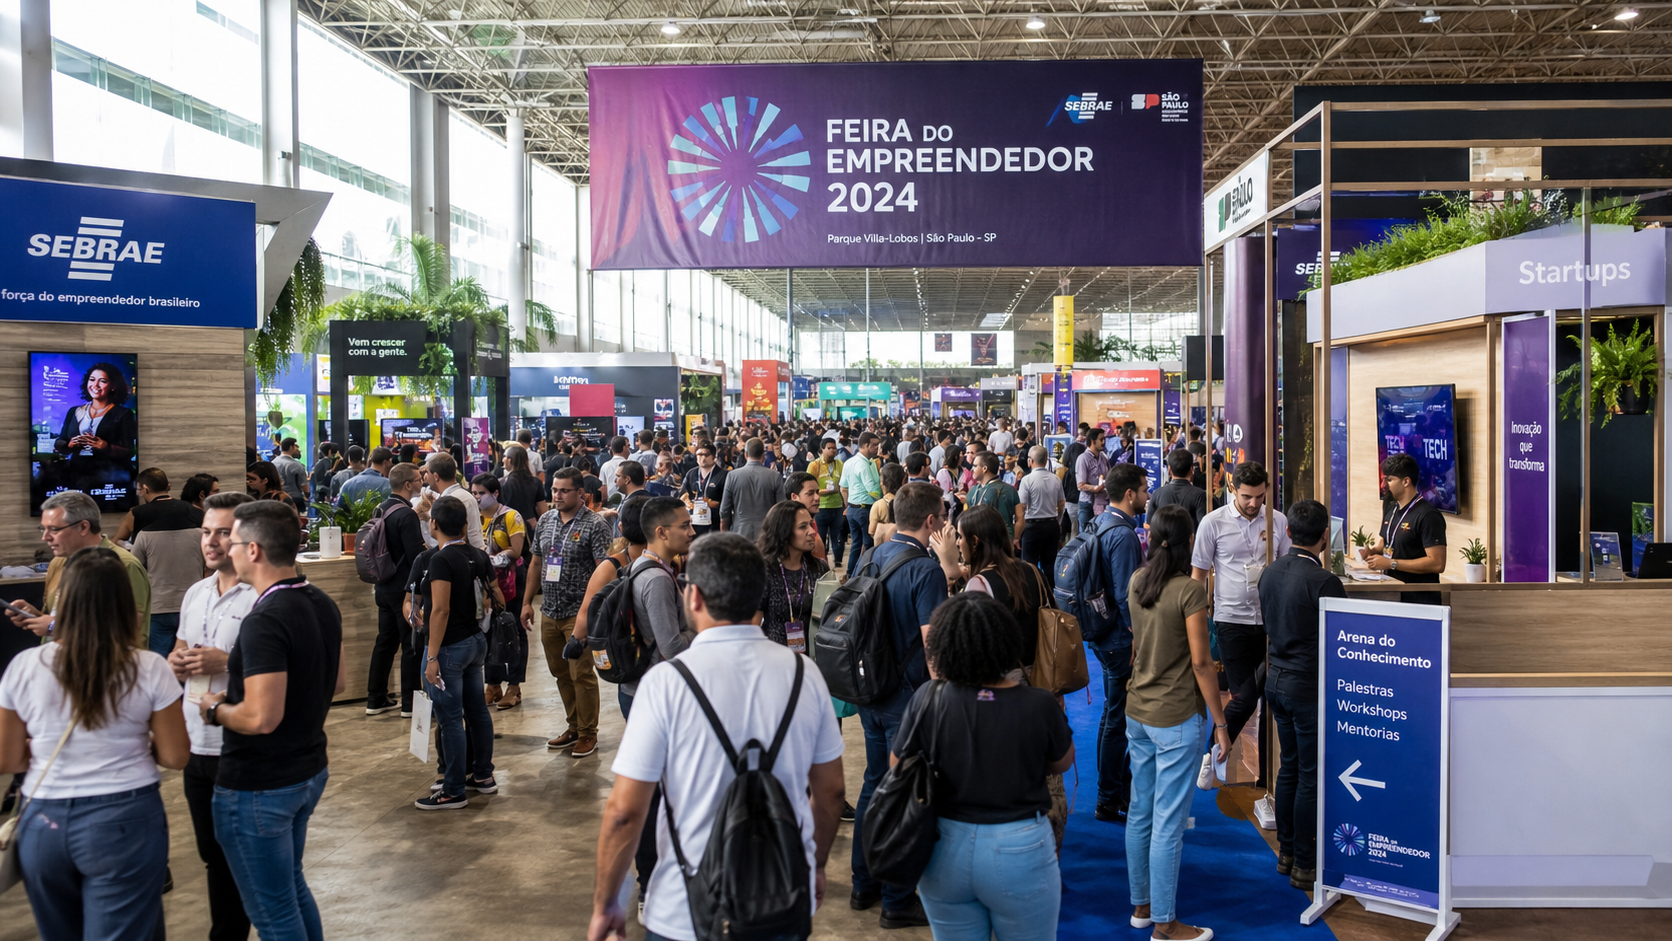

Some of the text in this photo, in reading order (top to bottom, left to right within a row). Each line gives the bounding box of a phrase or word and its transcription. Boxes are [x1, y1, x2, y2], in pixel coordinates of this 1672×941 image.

[1064, 101, 1113, 111] SEBRAE
[1161, 101, 1189, 109] PAULO
[826, 118, 954, 142] FEIRA DO
[826, 146, 1095, 173] EMPREENDEDOR
[826, 181, 919, 213] 2024
[827, 233, 862, 245] Parque
[863, 232, 918, 243] Villa-Lobos
[947, 232, 976, 243] Paulo
[983, 232, 997, 243] SP
[27, 233, 165, 265] SEBRAE
[1519, 260, 1631, 287] Startups
[1, 288, 200, 308] força do empreendedor brasileiro
[348, 348, 369, 356] com
[378, 348, 408, 358] gente.
[371, 339, 406, 347] crescer
[1422, 438, 1448, 461] TECH
[1519, 441, 1533, 455] que
[1509, 457, 1545, 472] transforma
[1337, 630, 1396, 648] Arena do
[1337, 646, 1432, 669] Conhecimento
[1337, 678, 1394, 698] Palestras
[1336, 698, 1408, 722] Workshops
[1337, 720, 1400, 741] Mentorias
[1368, 848, 1387, 858] 2024
